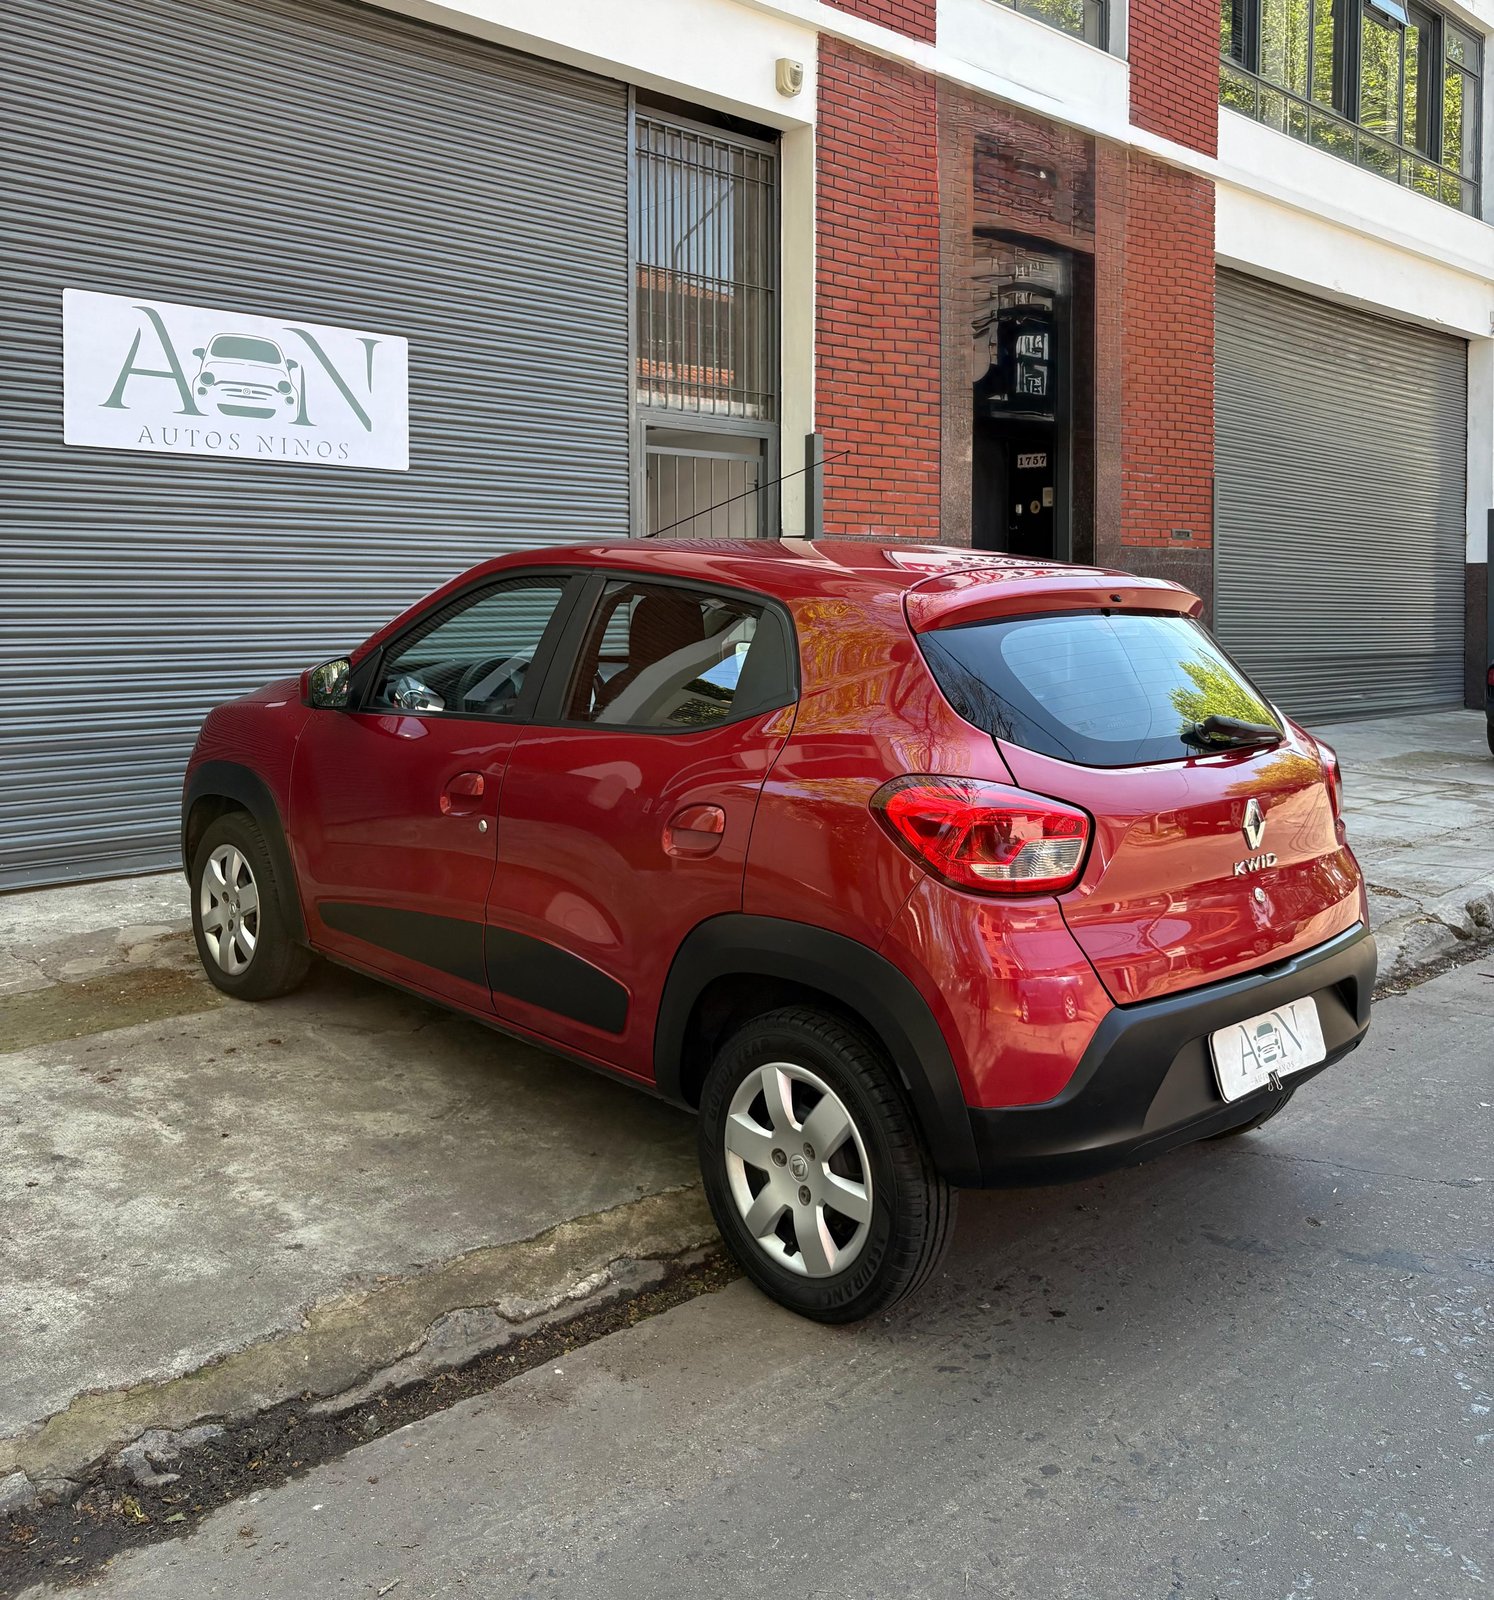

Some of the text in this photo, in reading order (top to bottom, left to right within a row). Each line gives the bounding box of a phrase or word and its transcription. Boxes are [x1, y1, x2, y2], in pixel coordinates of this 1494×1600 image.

[138, 425, 349, 460] AUTOS NINOS
[1018, 455, 1047, 467] 1757
[1232, 852, 1278, 877] KWID
